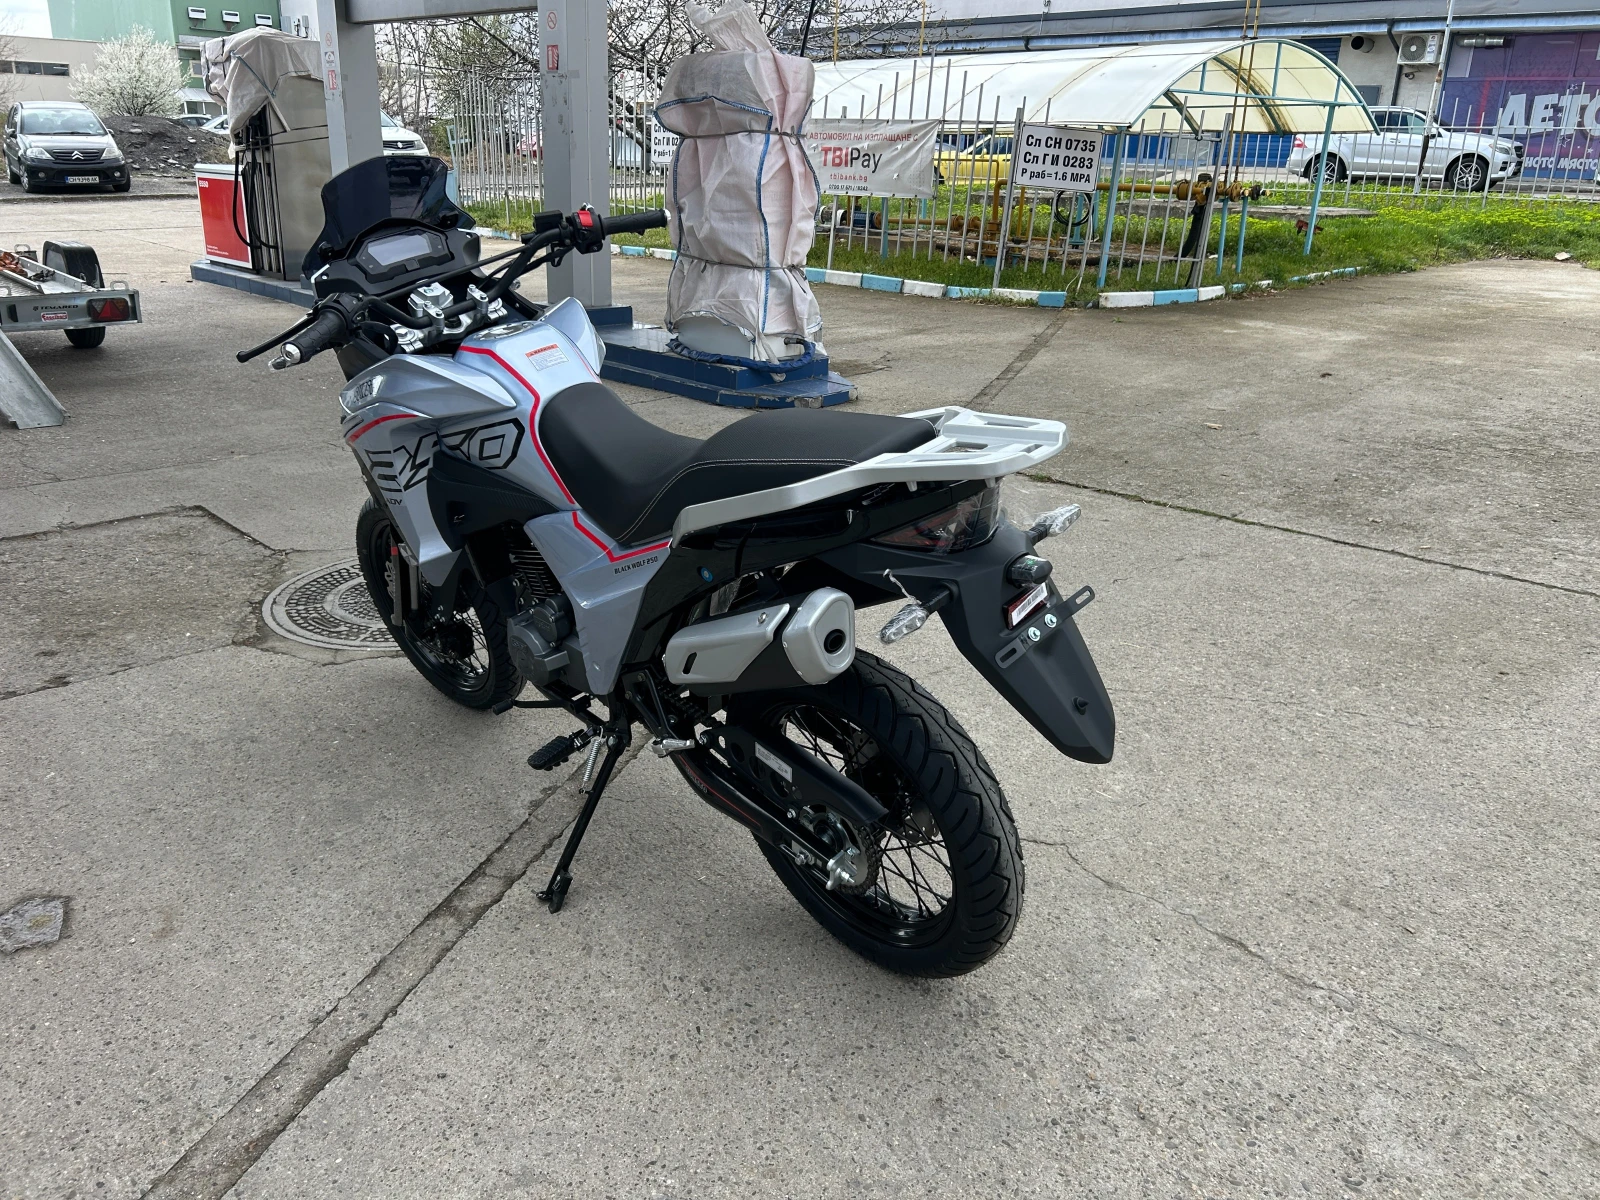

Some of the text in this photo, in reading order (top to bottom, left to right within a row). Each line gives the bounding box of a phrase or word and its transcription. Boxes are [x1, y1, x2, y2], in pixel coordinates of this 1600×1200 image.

[809, 132, 852, 141] АВТОМОБИЛ
[853, 133, 863, 141] НА
[865, 133, 912, 142] ИЗПЛАЩАНЕ
[1025, 134, 1042, 148] Сл
[1065, 138, 1096, 152] 0735
[821, 146, 882, 173] TBIPay
[1023, 151, 1039, 165] Сл
[1063, 155, 1094, 169] 0283
[829, 173, 868, 182] tbibank.bg
[614, 555, 659, 574] BLACK WOLF 250
